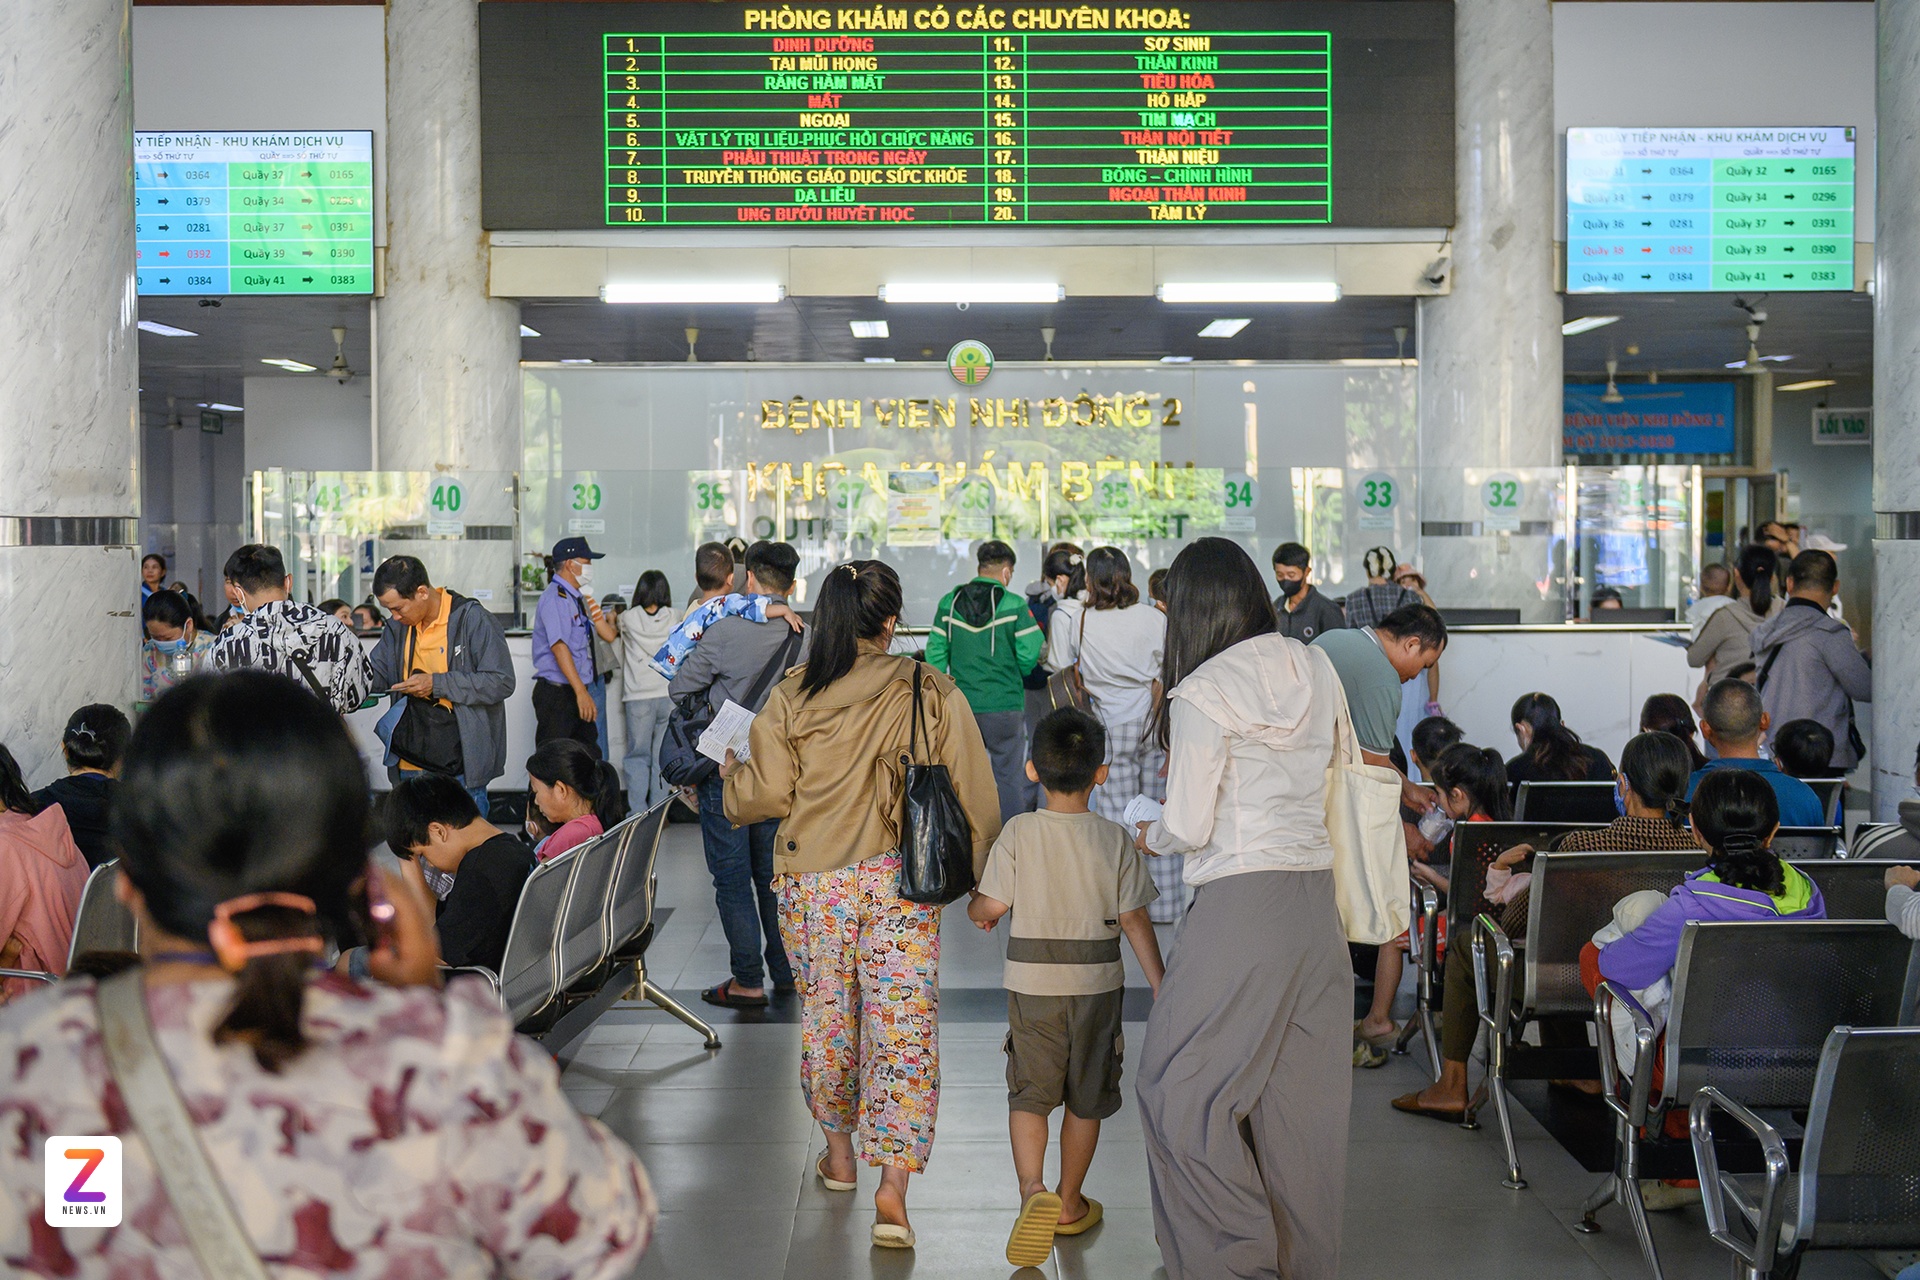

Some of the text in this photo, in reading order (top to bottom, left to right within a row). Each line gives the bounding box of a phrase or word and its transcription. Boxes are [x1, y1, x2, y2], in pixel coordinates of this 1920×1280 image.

[744, 5, 1191, 30] PHÒNG KHÁM CÓ CÁC CHUYÊN KHOA:
[626, 38, 640, 51] 1.
[772, 38, 810, 51] DINH
[994, 38, 1210, 51] 11. SƠ SINH
[626, 57, 640, 70] 2.
[768, 57, 796, 70] TAI
[994, 57, 1016, 70] 12.
[1180, 57, 1218, 69] KINH
[626, 76, 640, 89] 3.
[994, 75, 1016, 89] 13.
[626, 95, 640, 108] 4.
[994, 94, 1016, 107] 14.
[626, 113, 640, 127] 5.
[994, 113, 1016, 126] 15.
[1138, 113, 1168, 126] TIM
[146, 134, 344, 149] TIẾP NHẬN KHU KHÁM DỊCH VỤ
[626, 132, 640, 145] 6.
[712, 129, 732, 145] LÝ
[994, 132, 1016, 145] 16.
[626, 151, 640, 164] 7.
[824, 151, 880, 164] TRONG
[994, 150, 1016, 164] 17.
[186, 170, 210, 180] 0364
[272, 170, 284, 180] 32
[626, 170, 640, 183] 8.
[746, 166, 802, 183] THÔNG
[806, 166, 846, 183] GIÁO
[994, 169, 1016, 182] 18.
[1726, 166, 1836, 178] Quầy 32 0165
[186, 196, 210, 206] 0379
[626, 188, 640, 202] 9.
[794, 189, 818, 202] DA
[994, 188, 1016, 201] 19.
[1208, 188, 1246, 200] KINH
[1726, 192, 1836, 204] Quầy 34 0296
[625, 207, 646, 220] 10.
[994, 206, 1016, 220] 20.
[187, 223, 211, 232] 0281
[244, 222, 355, 236] Quầy 37 0391
[1726, 218, 1836, 230] Quầy 37 0391
[187, 250, 211, 258] 0392
[244, 249, 355, 262] Quầy 39 0390
[1725, 244, 1835, 257] Quầy 39 0390
[187, 276, 211, 285] 0384
[244, 275, 355, 288] Quầy 41 0383
[1725, 272, 1835, 284] Quầy 41 0383
[970, 397, 1030, 428] NHI
[1162, 398, 1182, 426] 2
[314, 486, 343, 512] 41
[432, 485, 461, 512] 40
[572, 483, 602, 510] 39
[696, 482, 725, 510] 38
[836, 482, 865, 510] 37
[1100, 482, 1128, 509] 35
[1224, 480, 1252, 508] 34
[1362, 480, 1392, 508] 33
[1488, 480, 1516, 508] 32
